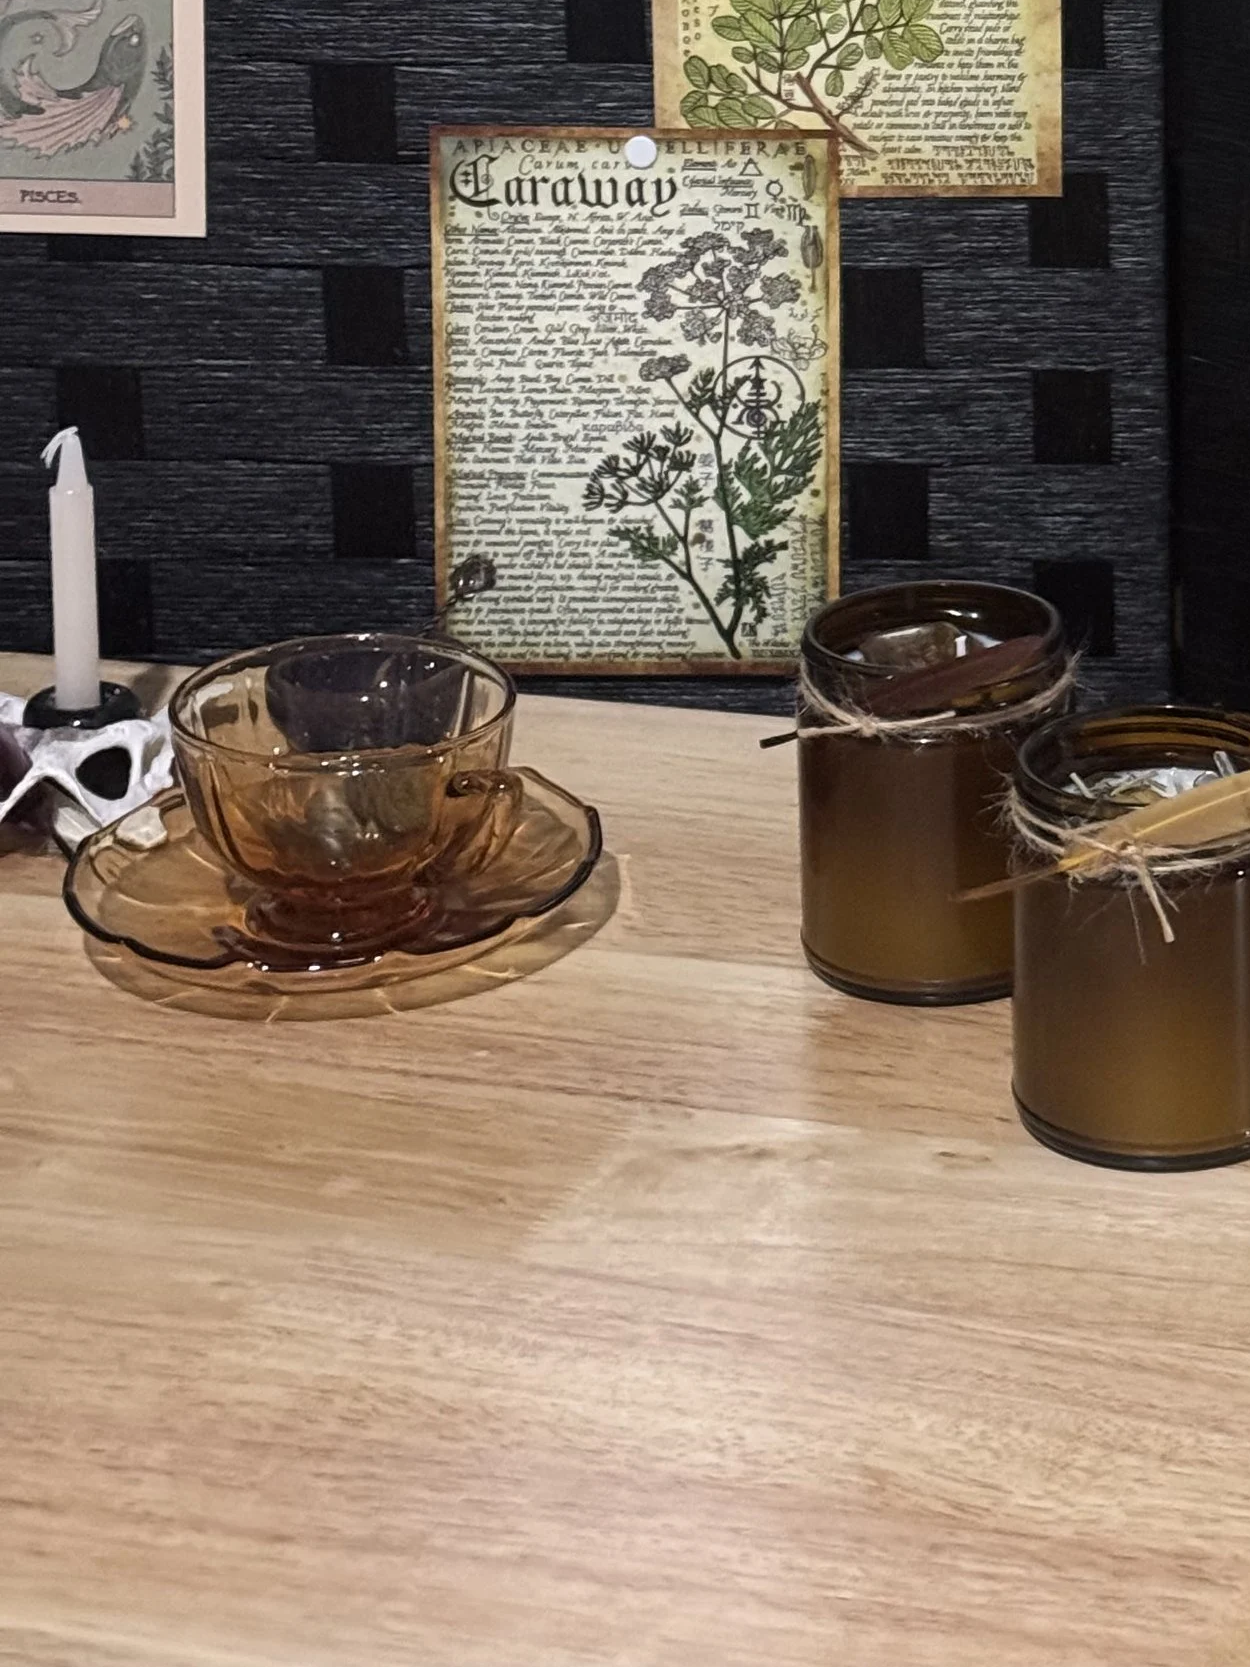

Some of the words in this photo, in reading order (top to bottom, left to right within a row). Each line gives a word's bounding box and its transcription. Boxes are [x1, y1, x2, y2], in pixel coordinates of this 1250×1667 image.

[452, 139, 588, 158] APIACEAE
[518, 154, 579, 176] Carum
[449, 152, 678, 220] Caraway
